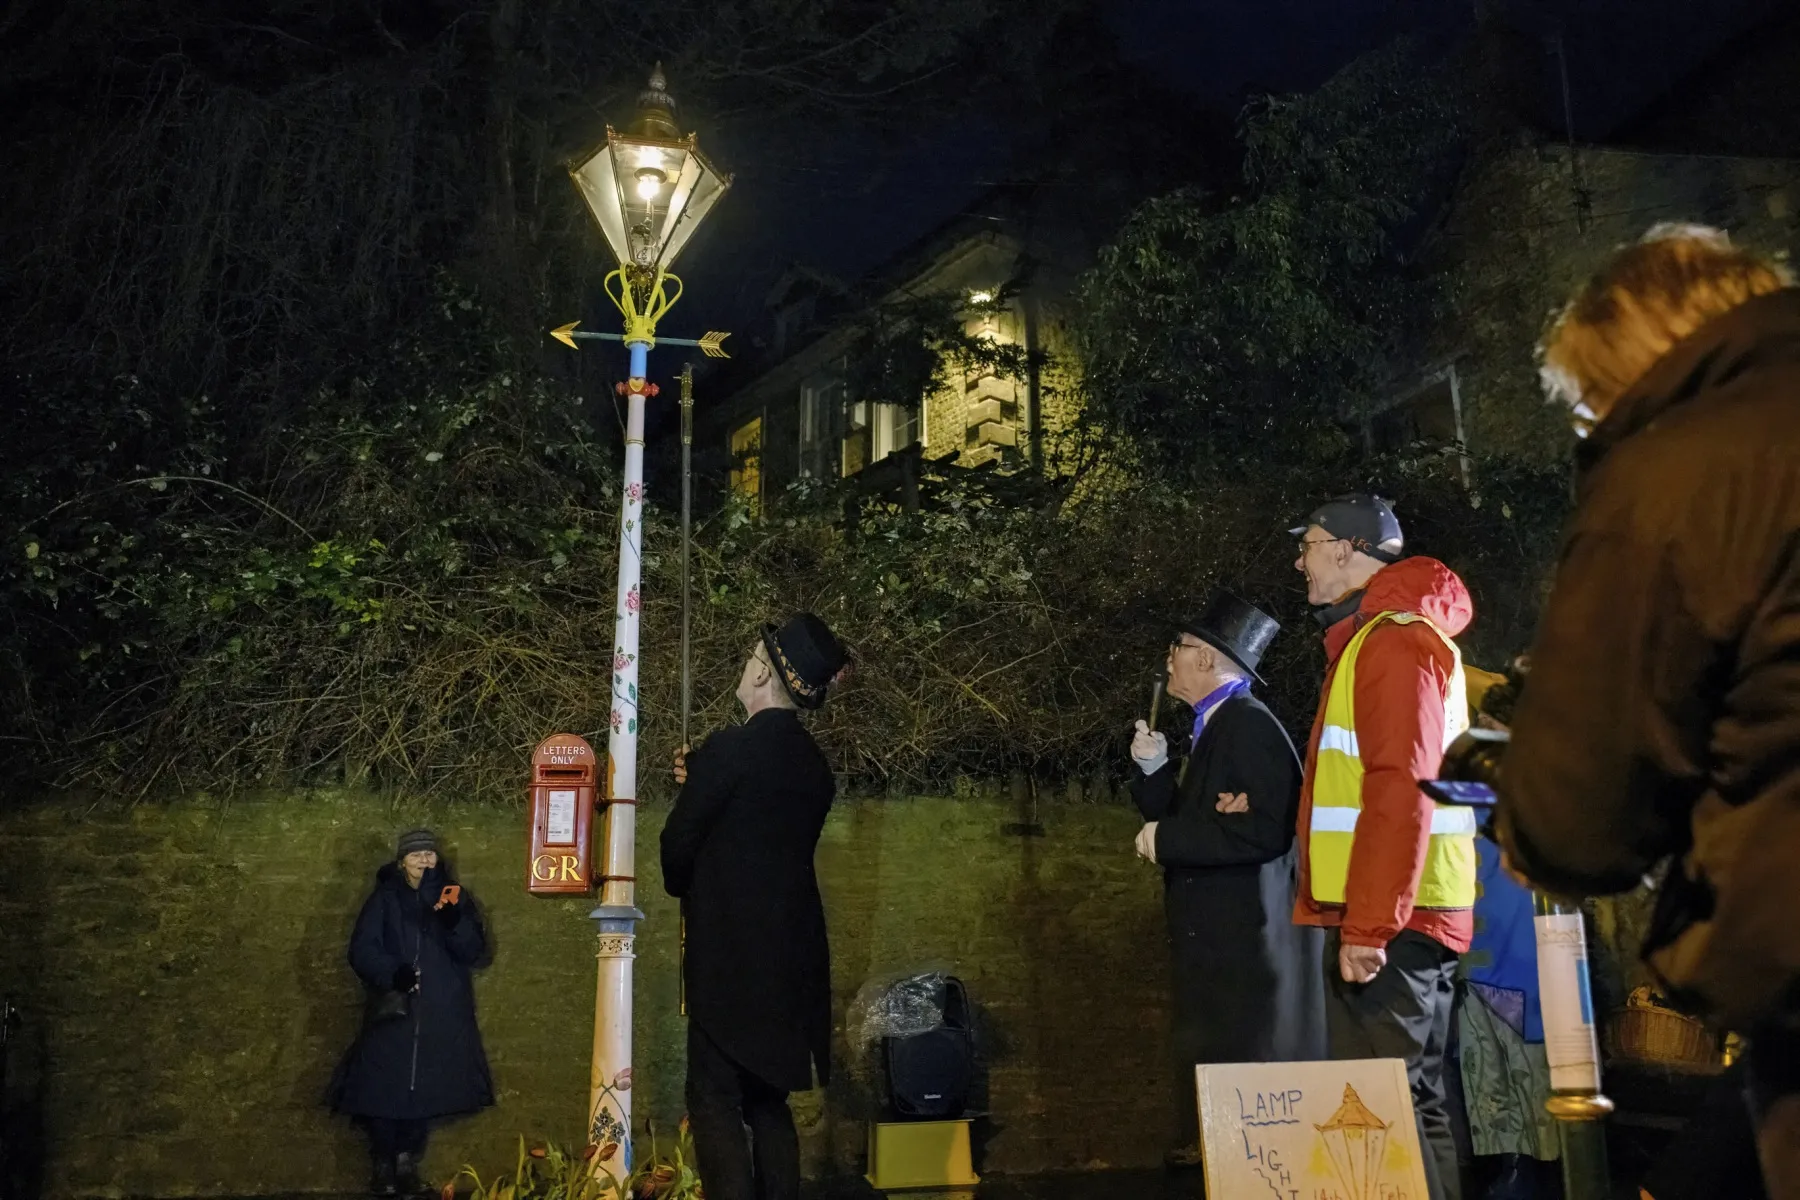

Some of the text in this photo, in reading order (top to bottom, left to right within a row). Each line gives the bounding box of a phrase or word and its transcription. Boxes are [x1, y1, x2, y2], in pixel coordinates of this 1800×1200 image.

[1350, 535, 1373, 552] LFC
[543, 746, 586, 755] LETTERS
[551, 755, 574, 765] ONLY
[532, 854, 583, 882] GR
[1235, 1087, 1303, 1120] LAMP
